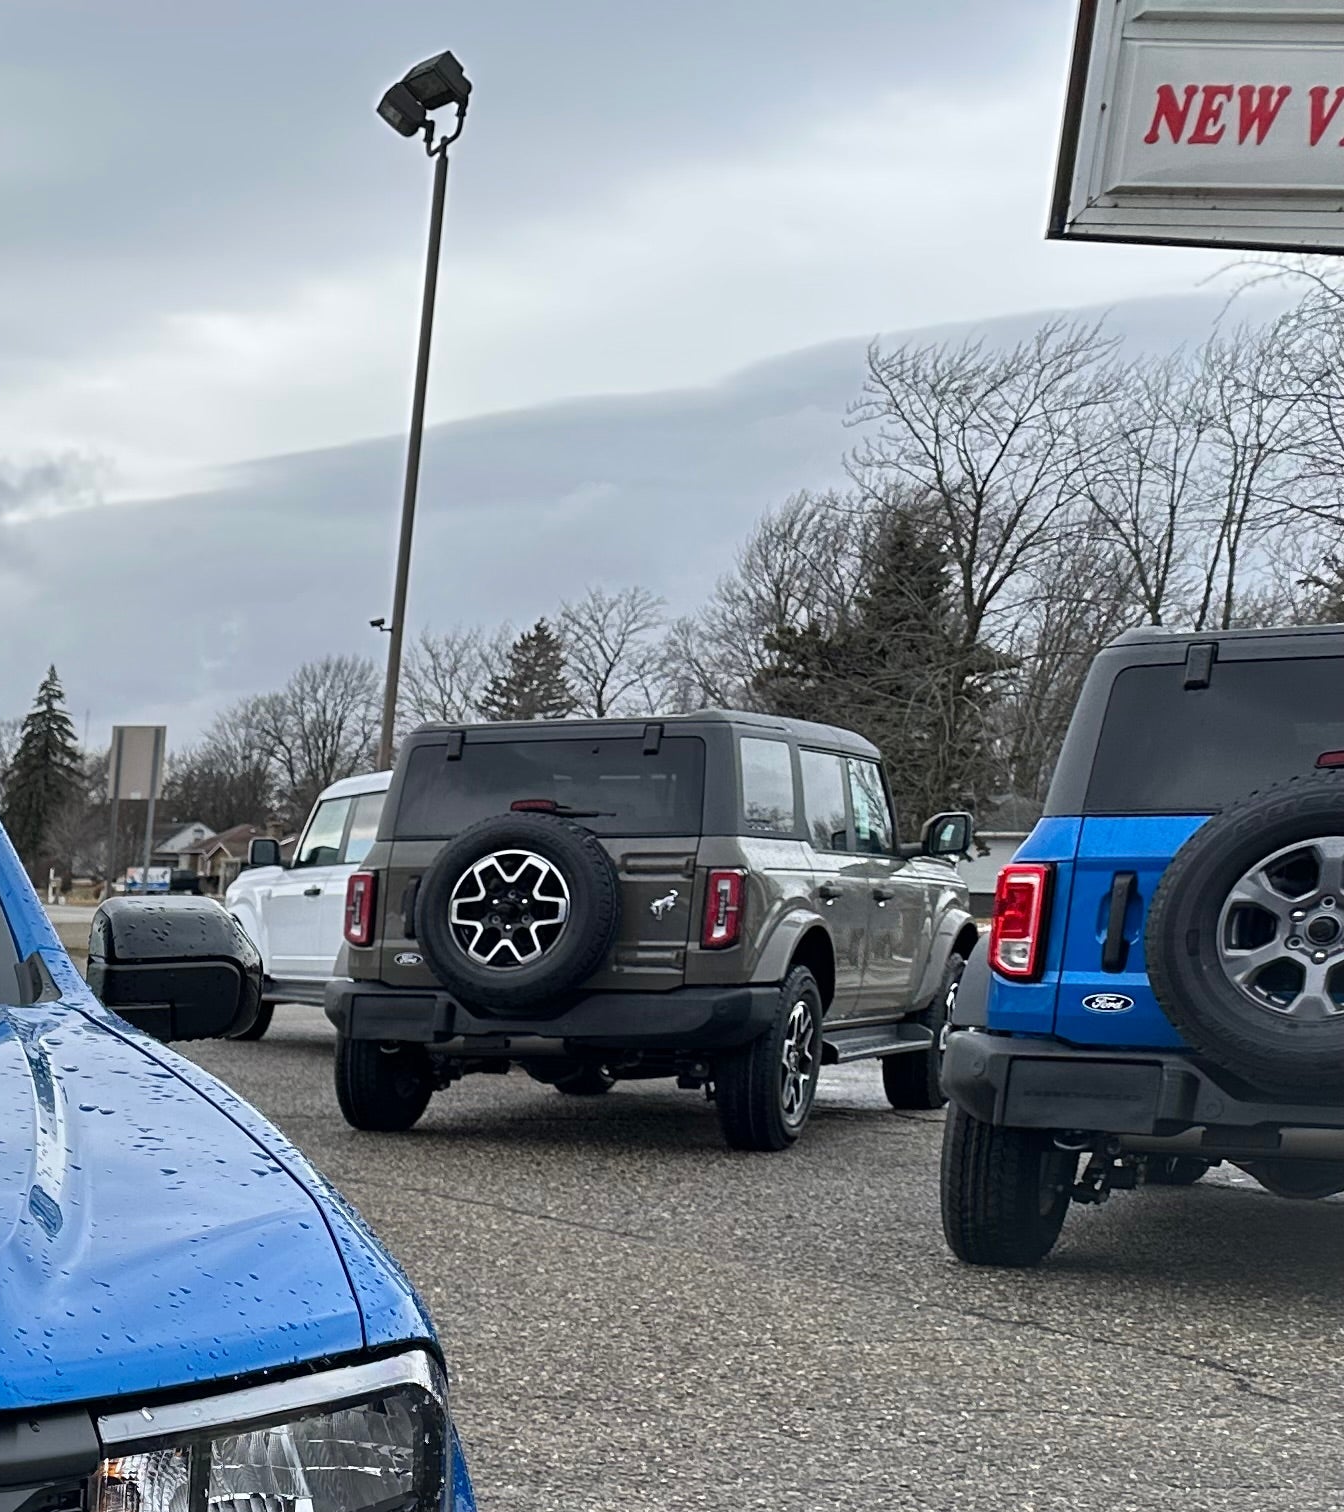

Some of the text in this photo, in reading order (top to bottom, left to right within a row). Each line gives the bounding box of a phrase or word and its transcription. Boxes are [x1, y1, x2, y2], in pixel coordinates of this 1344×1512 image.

[1144, 84, 1344, 147] NEW V
[1092, 996, 1124, 1009] Ford
